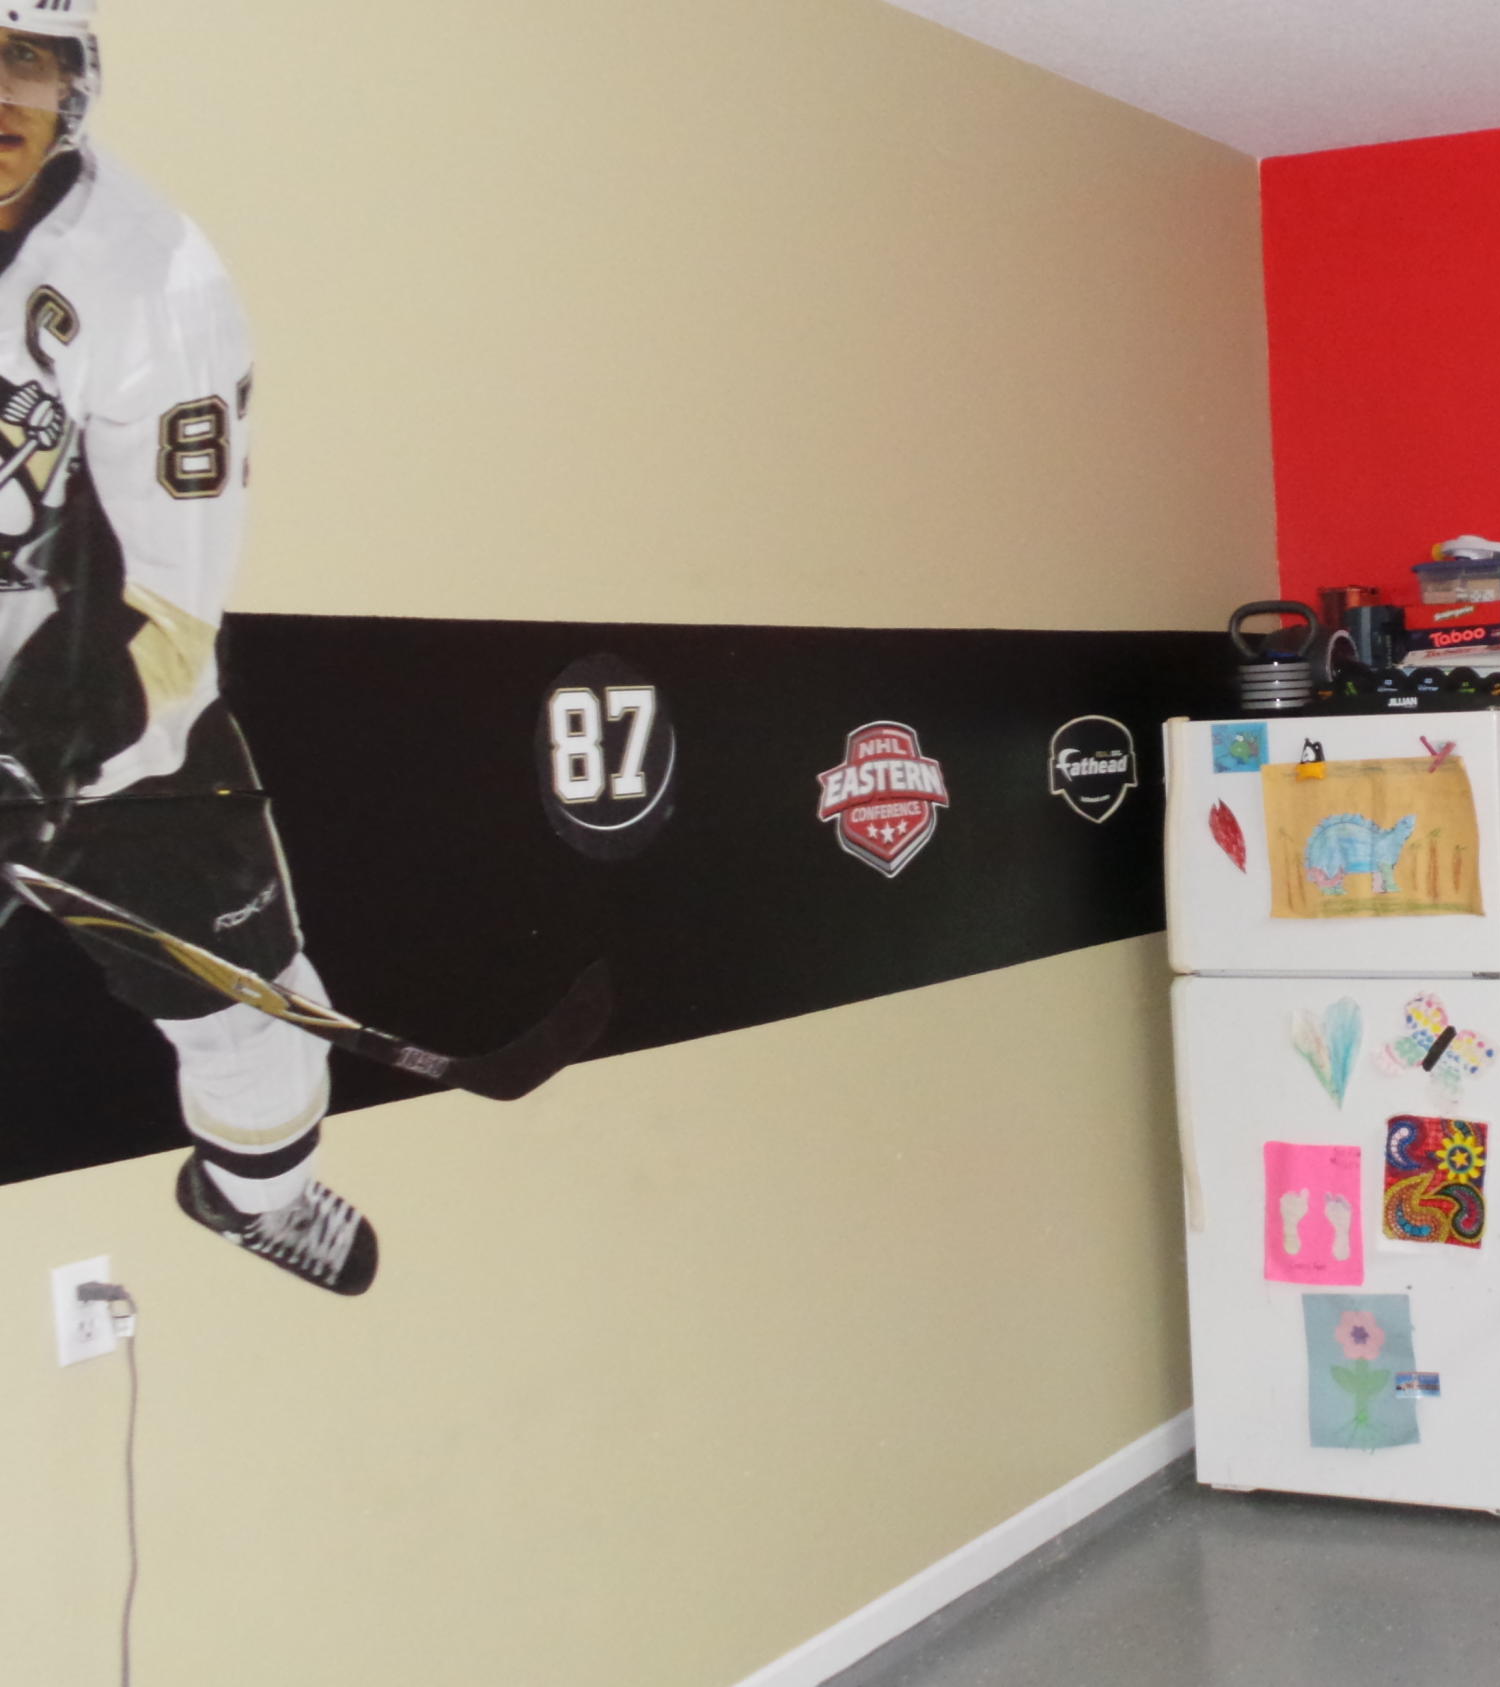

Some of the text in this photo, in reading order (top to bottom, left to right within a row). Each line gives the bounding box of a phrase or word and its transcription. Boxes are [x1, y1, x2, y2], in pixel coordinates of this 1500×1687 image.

[1430, 627, 1486, 648] Taboo
[548, 685, 656, 804] 87
[859, 738, 907, 759] NHL
[823, 759, 944, 808] EASTERN
[852, 800, 923, 823] CONFERENCE
